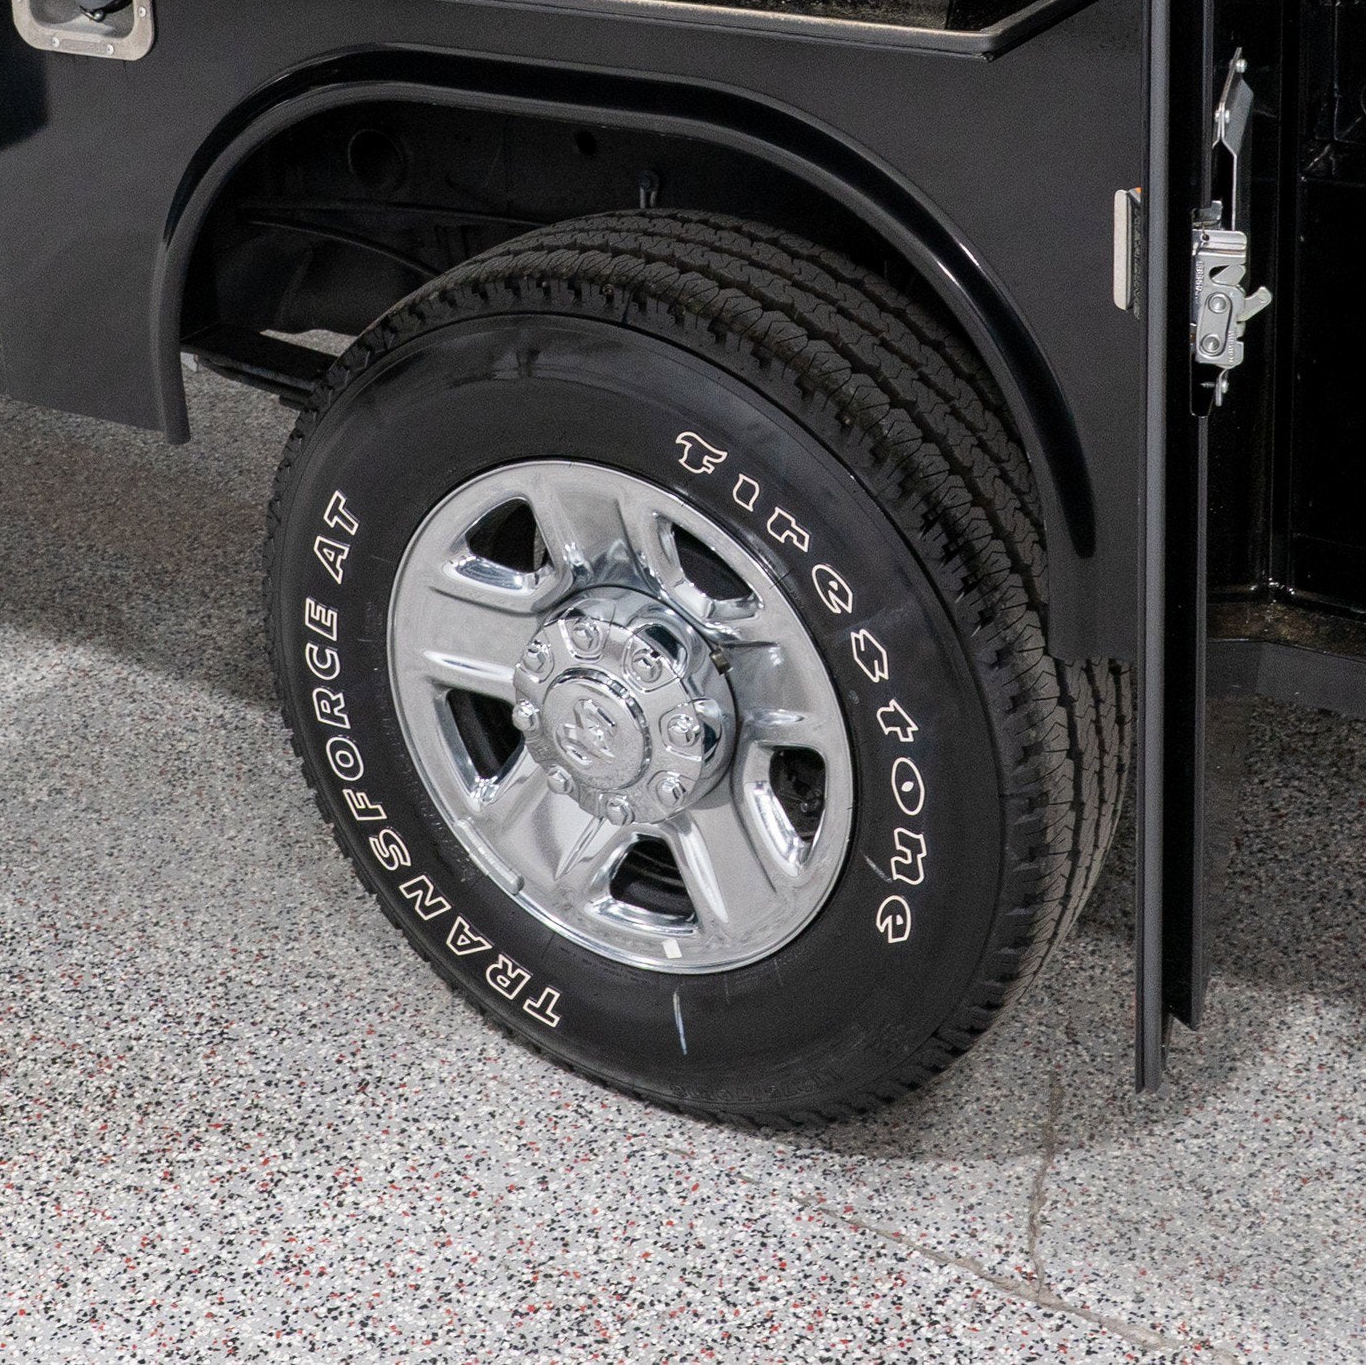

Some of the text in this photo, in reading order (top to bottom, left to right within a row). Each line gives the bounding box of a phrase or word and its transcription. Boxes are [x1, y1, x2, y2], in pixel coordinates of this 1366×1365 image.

[304, 490, 565, 1028] TRANSFORCE AT
[675, 430, 927, 944] Firestone
